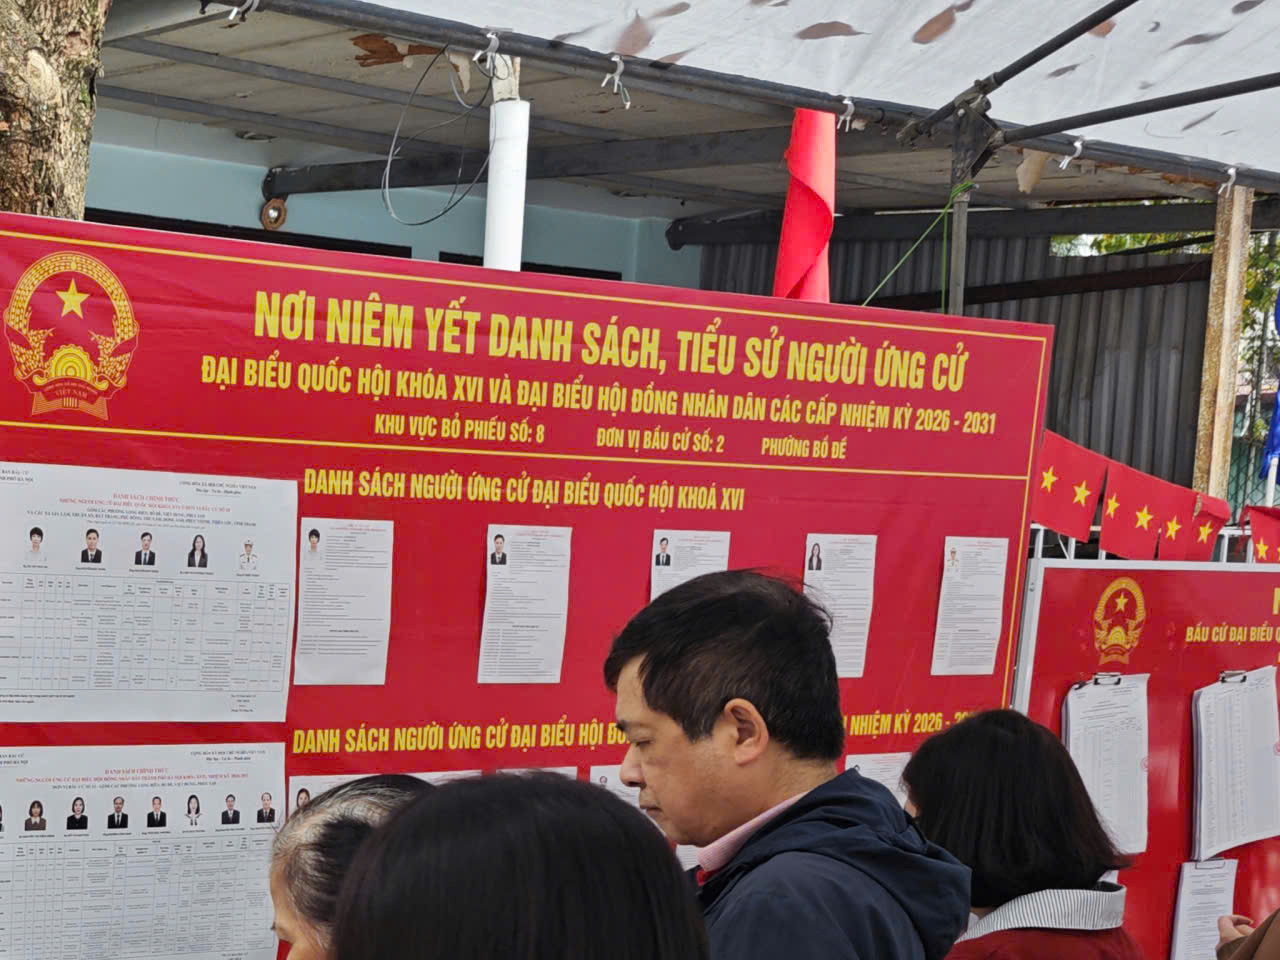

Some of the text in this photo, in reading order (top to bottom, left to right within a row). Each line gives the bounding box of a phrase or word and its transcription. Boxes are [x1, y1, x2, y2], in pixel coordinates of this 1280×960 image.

[254, 290, 969, 392] NƠI NIÊM YẾT DANH SÁCH, TIỂU SỬ NGƯỜI ỨNG CỬ
[201, 356, 238, 391] ĐẠI
[243, 349, 291, 389] BIỂU
[297, 356, 351, 394] QUỐC
[357, 364, 390, 401] HỘI
[396, 367, 447, 401] KHÓA
[452, 376, 483, 403] XVI
[489, 374, 512, 405] VÀ
[517, 380, 547, 412] ĐẠI
[552, 375, 593, 410] BIỂU
[597, 383, 627, 418] HỘI
[631, 381, 678, 416] ĐỒNG
[682, 389, 729, 420] NHÂN
[732, 392, 766, 422] DÂN
[770, 394, 801, 425] CÁC
[805, 393, 837, 425] CẤP
[840, 400, 890, 433] NHIỆM
[892, 402, 912, 430] KỲ
[914, 408, 951, 433] 2026
[963, 412, 997, 435] 2031
[374, 412, 545, 444] KHU VỰC BỎ PHIẾU SỐ: 8
[596, 425, 725, 454] ĐƠN VỊ BẦU CỬ SỐ: 2
[761, 436, 811, 459] PHƯỜNG
[304, 465, 745, 515] DANH SÁCH NGƯỜI ỨNG CỬ ĐẠI BIỂU QUỐC HỘI KHOÁ XVI
[1186, 621, 1209, 642] BẦU
[1211, 621, 1228, 642] CỬ
[1229, 626, 1247, 645] ĐẠI
[1250, 620, 1273, 642] BIỂU
[292, 728, 340, 753] DANH
[345, 723, 390, 752] SÁCH
[394, 721, 444, 751] NGƯỜI
[448, 720, 481, 750] ỨNG
[485, 717, 508, 749] CỬ
[510, 723, 537, 752] ĐẠI
[540, 714, 574, 747] BIỂU
[578, 717, 604, 751] HỘI
[849, 709, 892, 739] NHIỆM
[893, 708, 912, 734] KỲ
[912, 712, 943, 733] 2026
